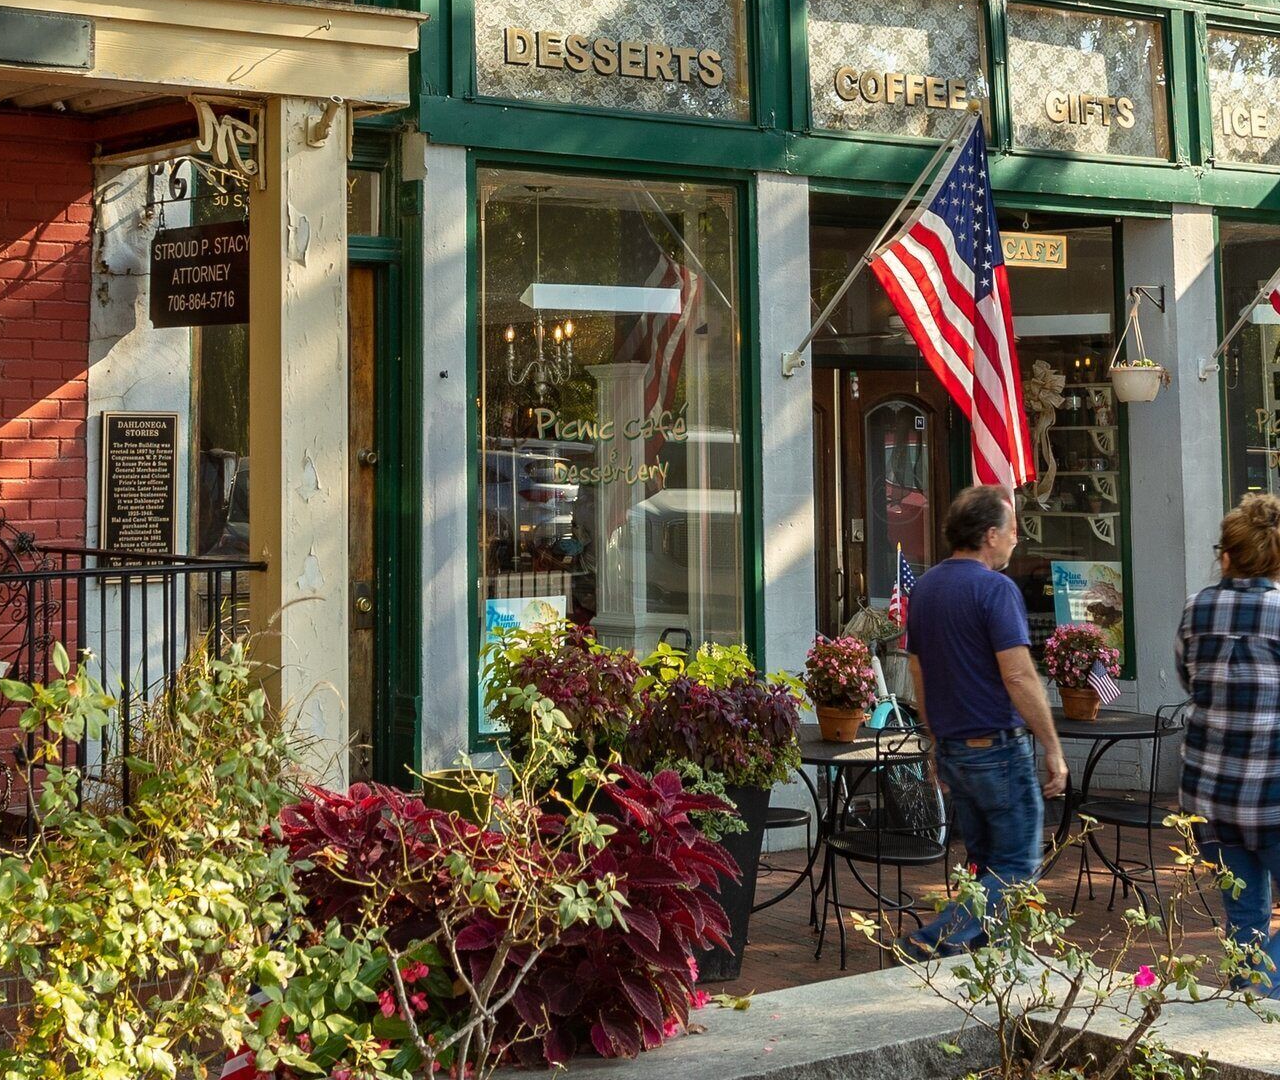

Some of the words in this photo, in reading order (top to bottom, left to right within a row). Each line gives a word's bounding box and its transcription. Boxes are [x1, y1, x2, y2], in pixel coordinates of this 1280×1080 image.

[504, 27, 723, 88] DESSERTS
[834, 66, 969, 112] COFFEE
[1044, 90, 1136, 129] GIFTS
[1221, 104, 1268, 139] ICE
[155, 240, 198, 260] STROUD
[201, 239, 212, 256] P.
[214, 236, 251, 254] STACY
[172, 264, 231, 285] ATTORNEY
[168, 291, 235, 312] 706-864-5716
[117, 421, 167, 429] DAHLONEGA
[125, 429, 159, 437] STORIES
[535, 408, 615, 442] Picnic
